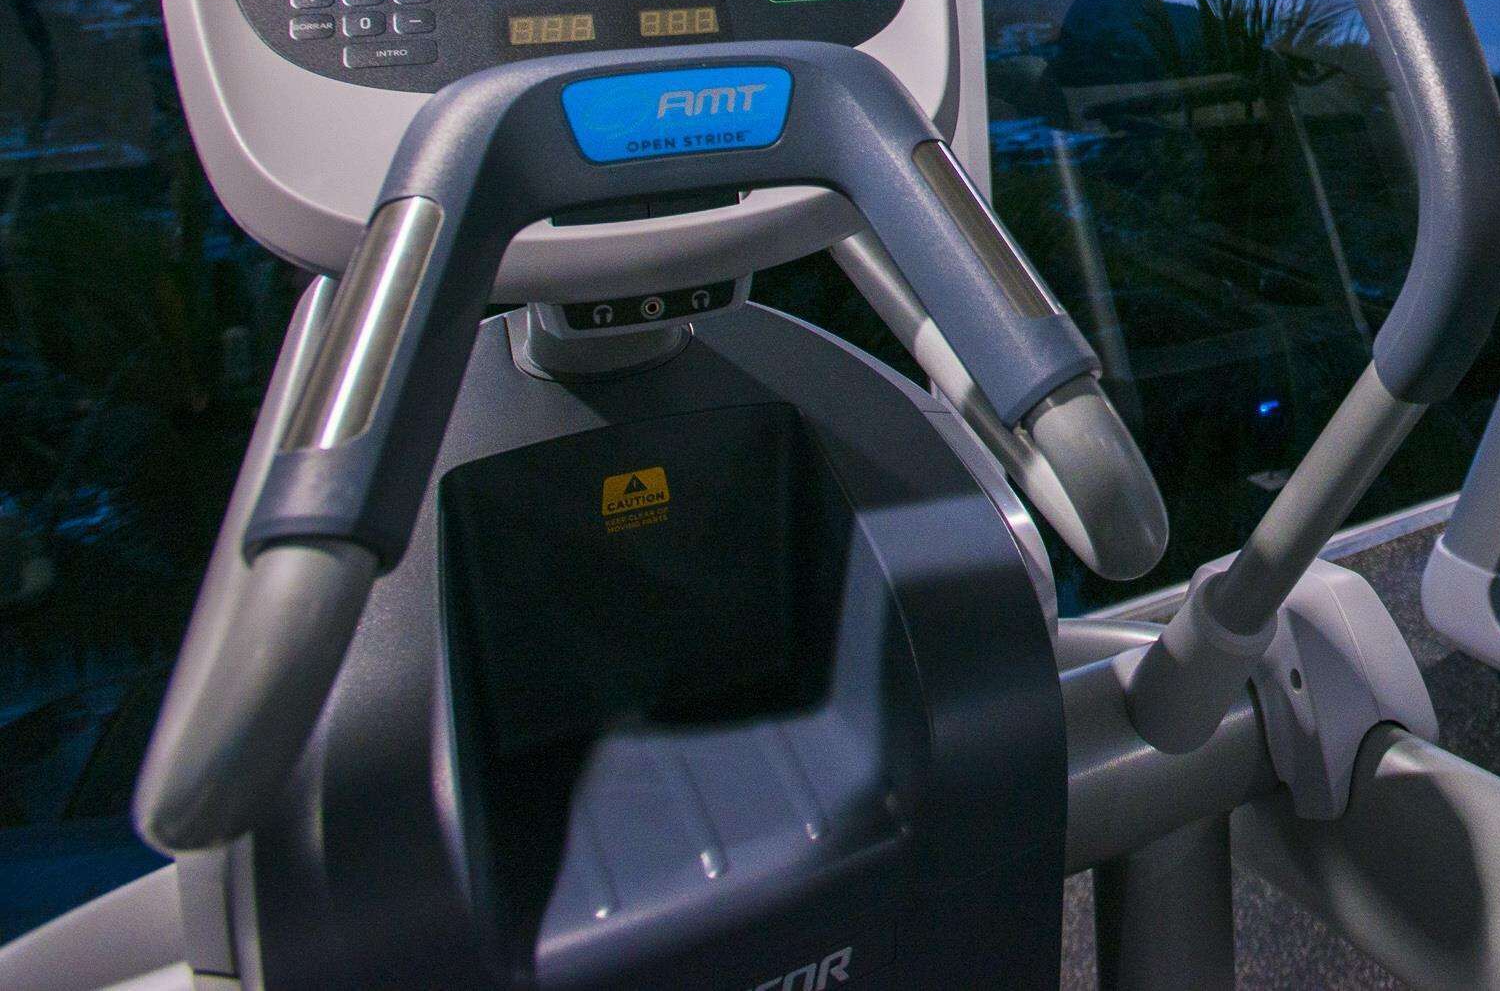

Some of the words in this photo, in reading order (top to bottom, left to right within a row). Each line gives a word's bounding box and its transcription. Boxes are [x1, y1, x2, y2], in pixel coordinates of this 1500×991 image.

[359, 17, 371, 29] 0
[376, 49, 408, 57] INTRO
[657, 83, 767, 119] AMT
[625, 137, 676, 154] OPEN
[607, 490, 665, 512] CAUTION
